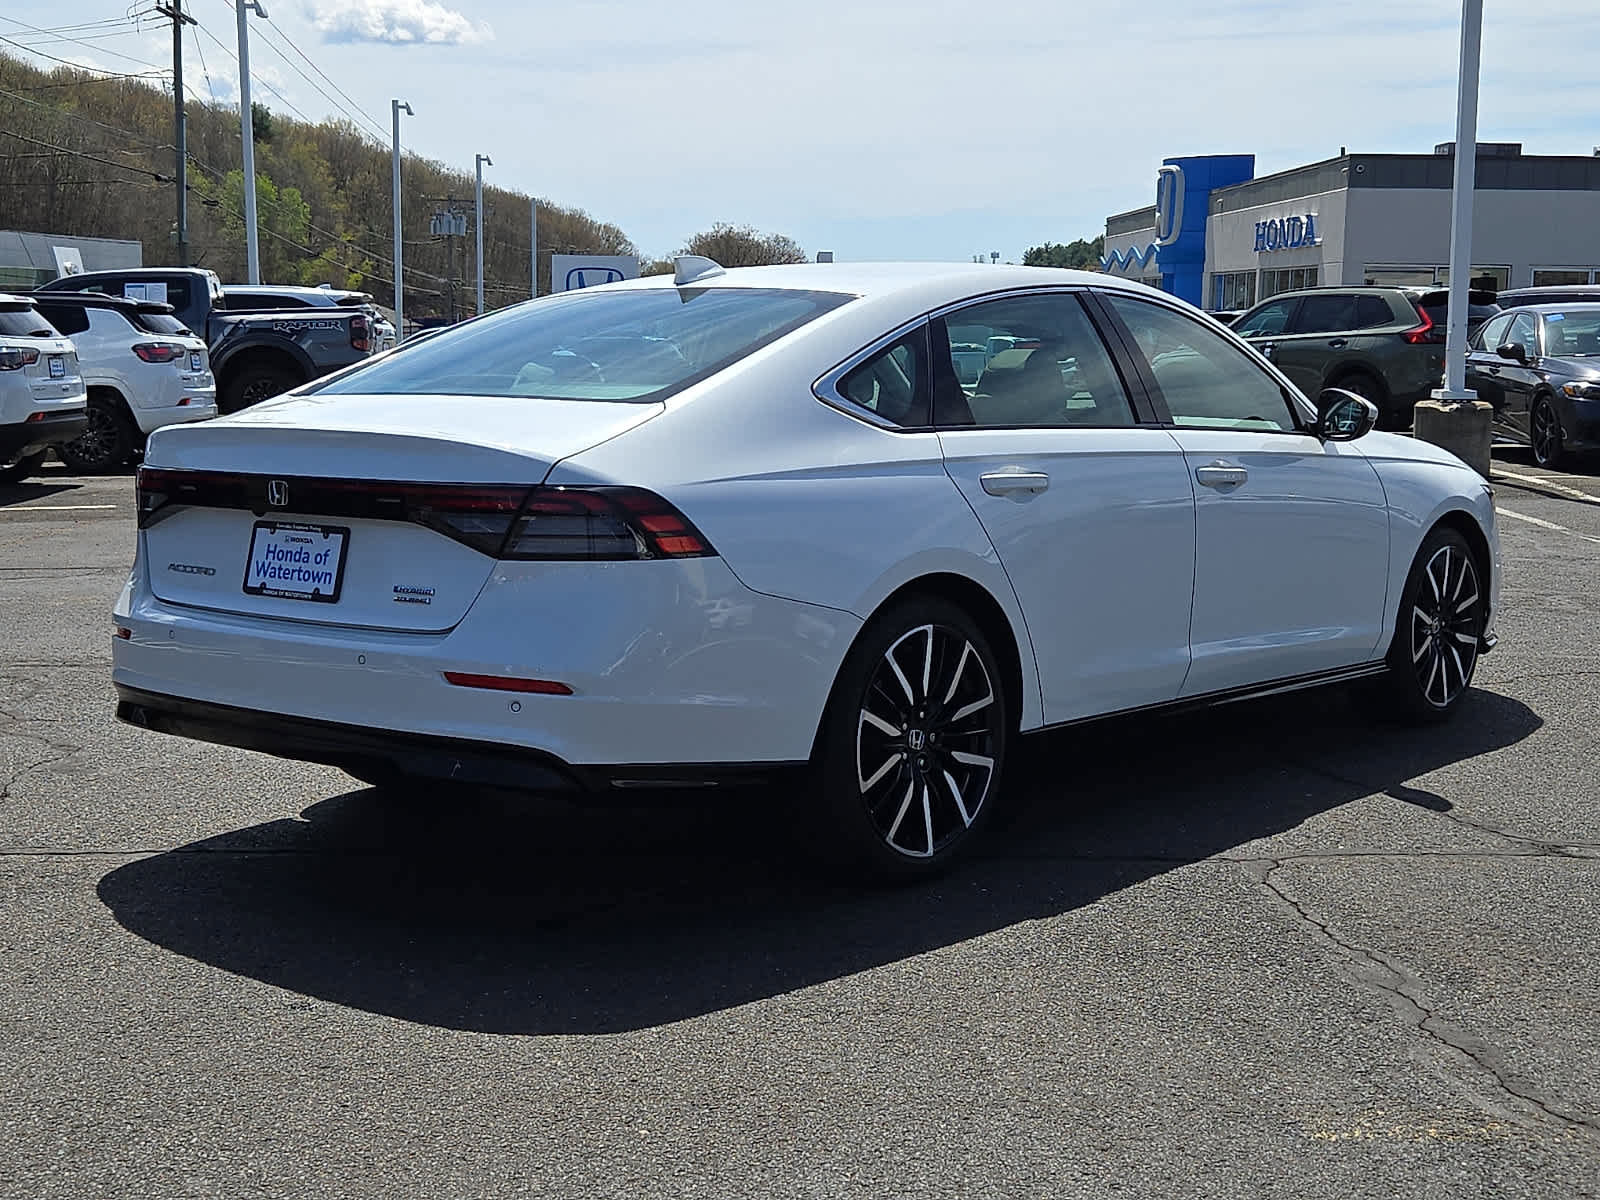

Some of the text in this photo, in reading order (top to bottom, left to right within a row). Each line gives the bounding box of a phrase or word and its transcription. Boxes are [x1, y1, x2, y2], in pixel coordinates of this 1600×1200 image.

[1254, 213, 1319, 252] HONDA
[273, 321, 344, 333] RAPTOR
[265, 543, 331, 565] Honda of
[255, 559, 333, 585] Watertown
